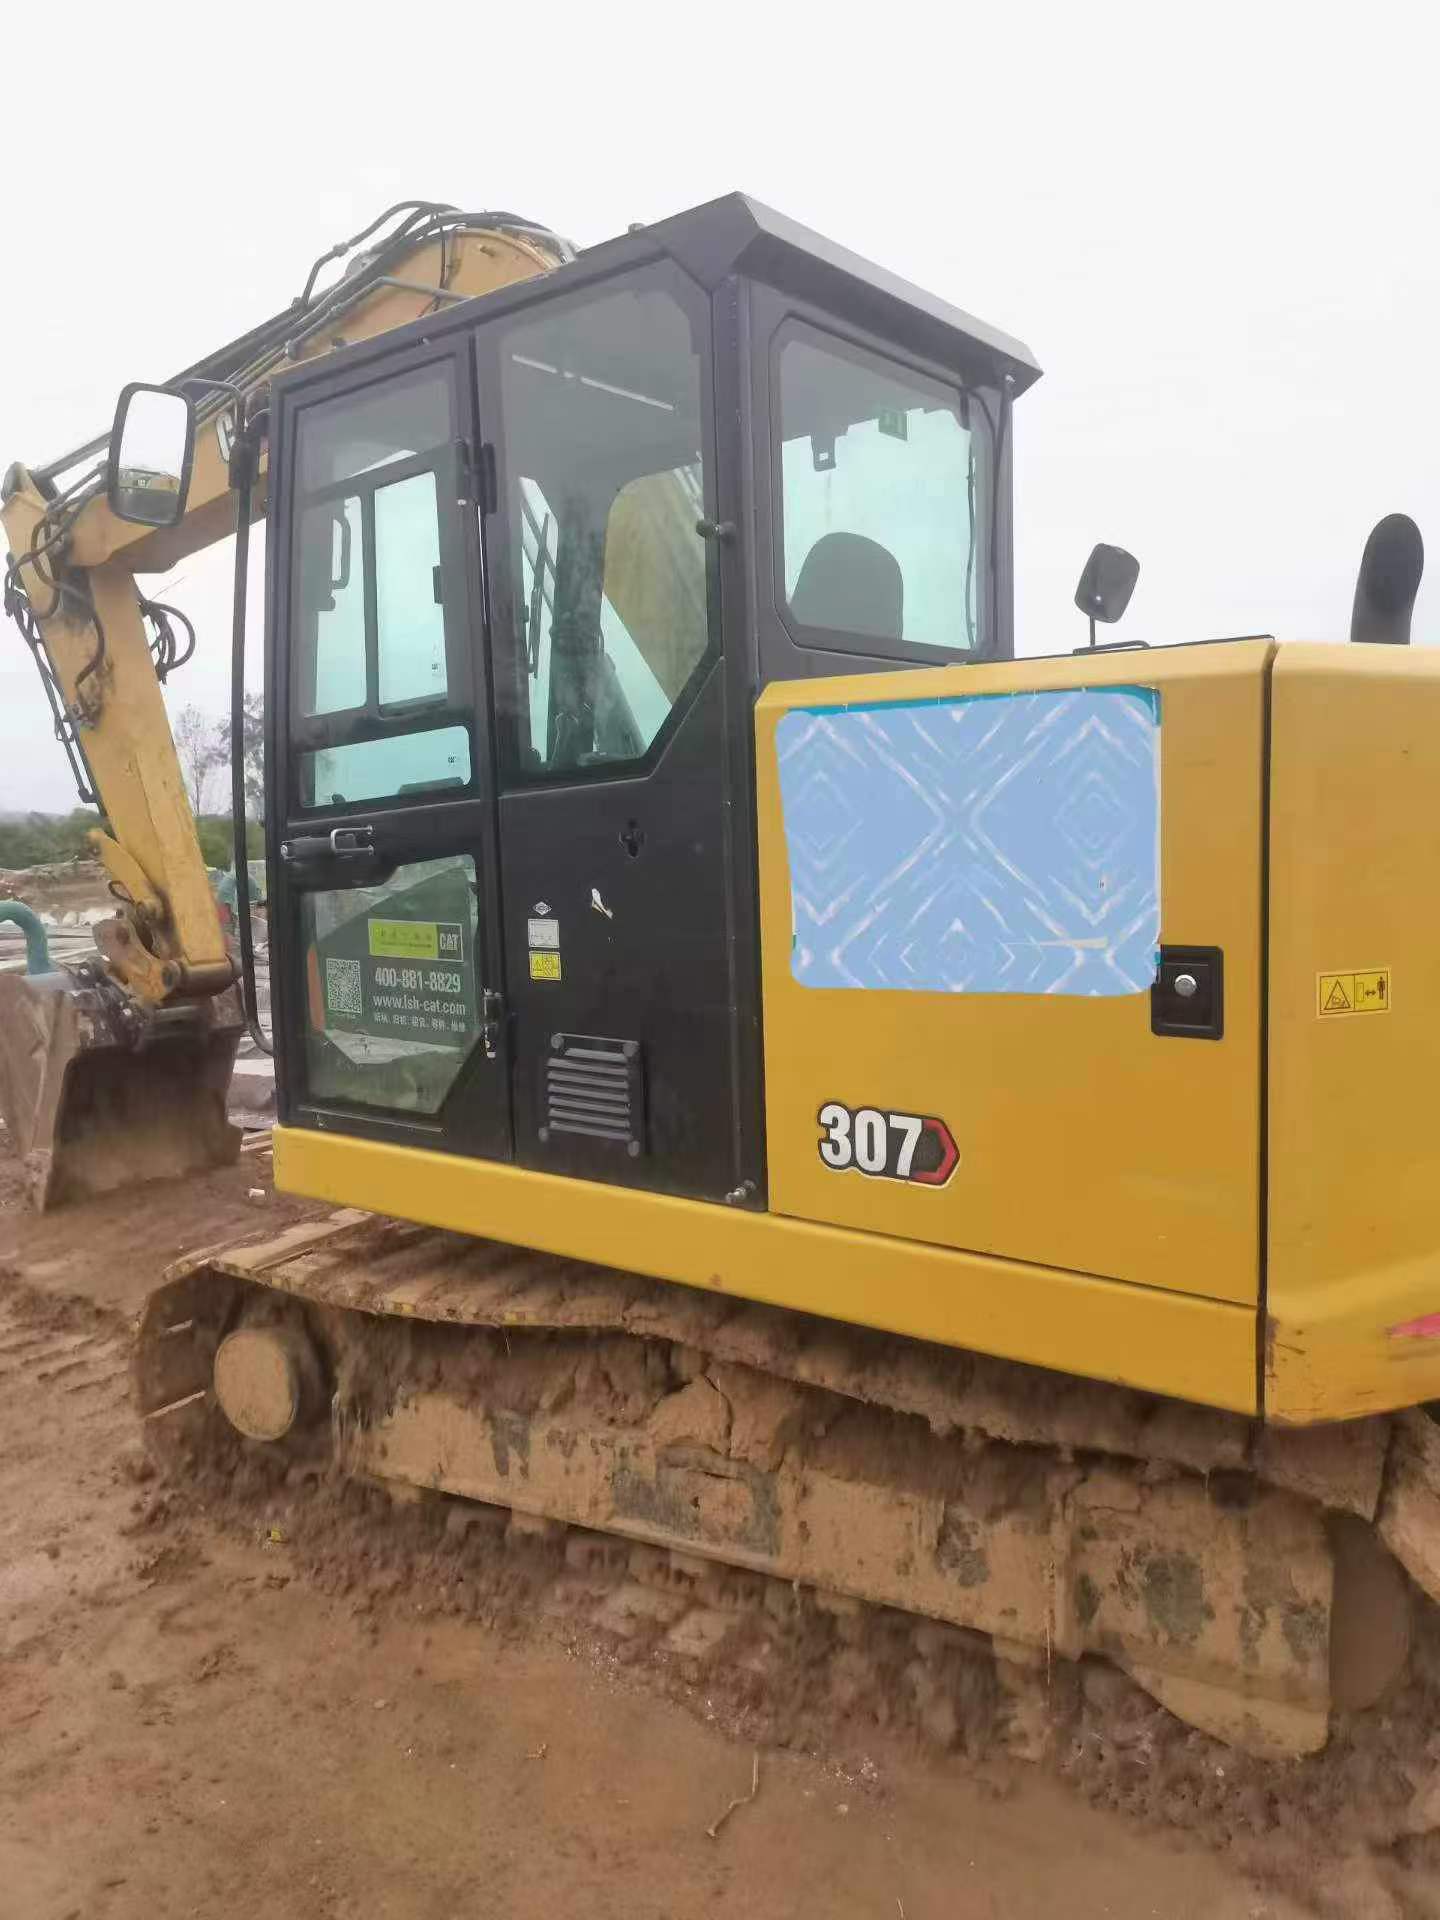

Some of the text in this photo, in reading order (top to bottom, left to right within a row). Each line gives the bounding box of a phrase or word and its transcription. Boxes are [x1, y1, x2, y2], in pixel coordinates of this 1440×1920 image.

[439, 933, 459, 951] CAT
[374, 966, 461, 993] 400-881-8829
[373, 994, 466, 1016] www.lsh-cat.com
[820, 1104, 923, 1177] 307
